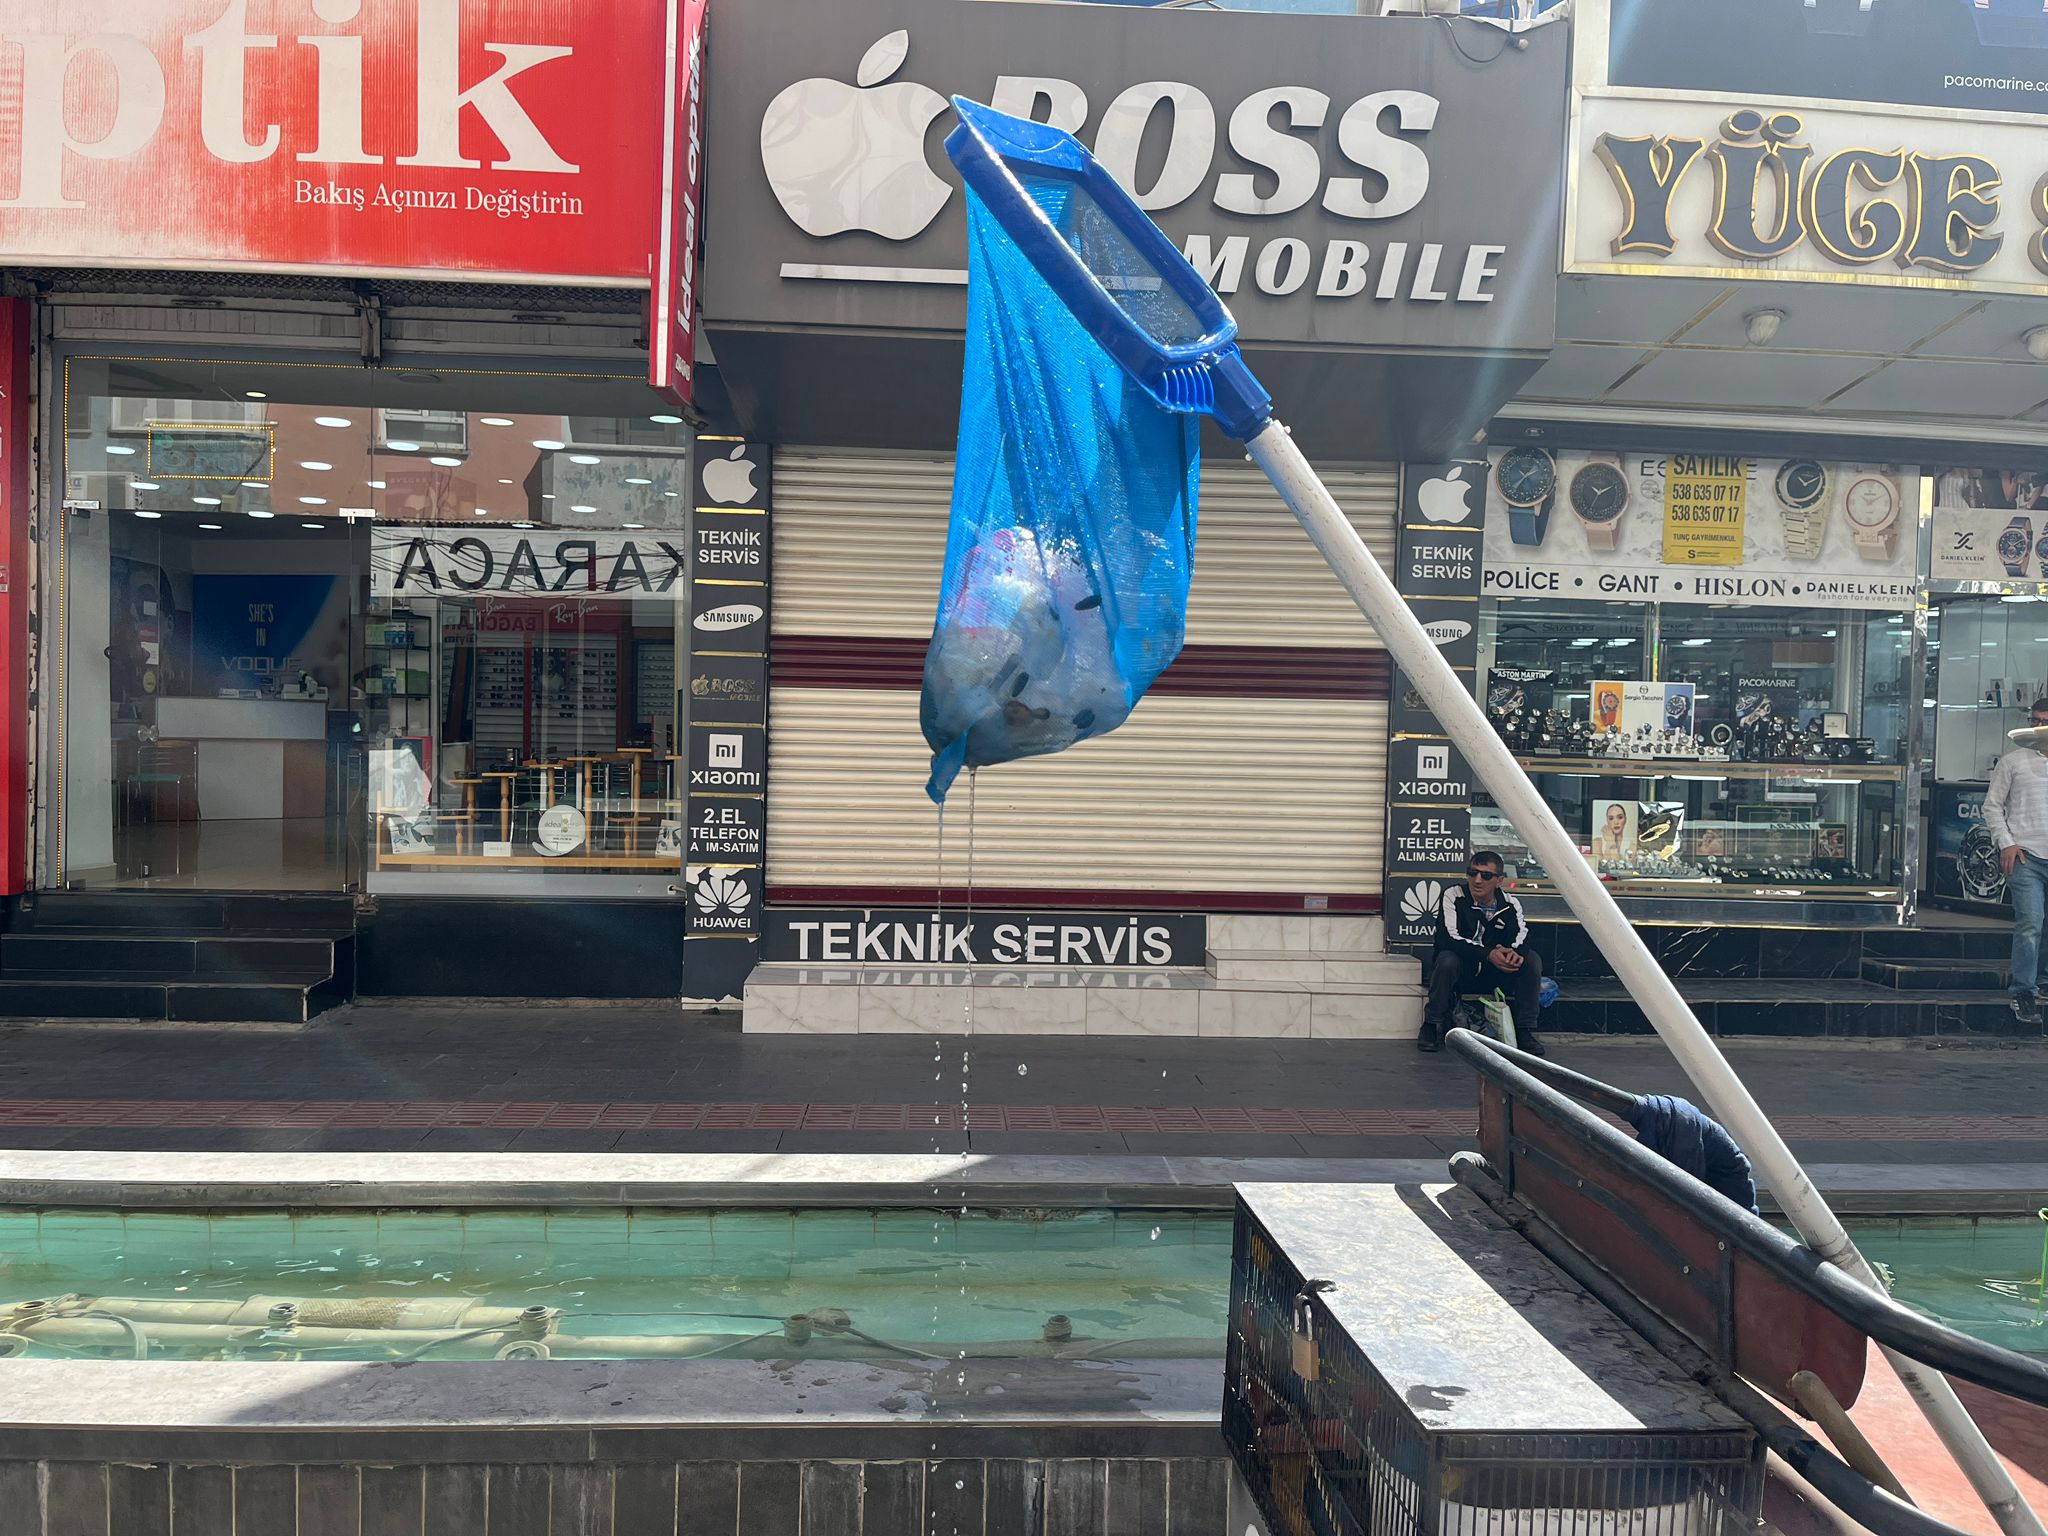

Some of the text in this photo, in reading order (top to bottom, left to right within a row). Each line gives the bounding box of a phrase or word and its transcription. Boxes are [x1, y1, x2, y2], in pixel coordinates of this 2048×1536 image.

[677, 191, 695, 334] ideal
[687, 24, 701, 185] optik
[294, 180, 584, 220] Bakış Açınızı Değiştirin
[1184, 236, 1507, 302] MOBILE
[1672, 483, 1740, 502] 538 635 07 17
[1671, 504, 1740, 523] 538 635 07 17
[698, 528, 761, 546] TEKNİK
[698, 547, 760, 565] SERVİS
[1411, 544, 1473, 561] TEKNİK
[1411, 563, 1472, 580] SERVİS
[1483, 567, 1916, 597] POLİCE GANT HISLON DANIEL KLEIN
[248, 603, 274, 623] SHE'S
[549, 598, 599, 624] Ray-Ban
[703, 612, 754, 624] SAMSUNG
[256, 627, 267, 647] IN
[1426, 628, 1463, 638] MSUNG
[1520, 671, 1547, 680] MARTIN
[1738, 678, 1796, 688] PACOMARINE
[690, 770, 760, 786] xiaomi
[1398, 781, 1466, 796] xiaomi
[703, 808, 746, 824] 2.EL
[1957, 803, 1985, 818] CA
[690, 827, 759, 840] TELEFON
[1410, 818, 1452, 835] 2.EL
[690, 842, 759, 853] AIM-SATIM
[1397, 837, 1464, 850] TELEFON
[1397, 852, 1464, 862] ALIM-SATIM
[693, 917, 751, 929] HUAWEI
[1399, 925, 1438, 936] HUAW
[789, 914, 1172, 967] TEKNİK SERVİS
